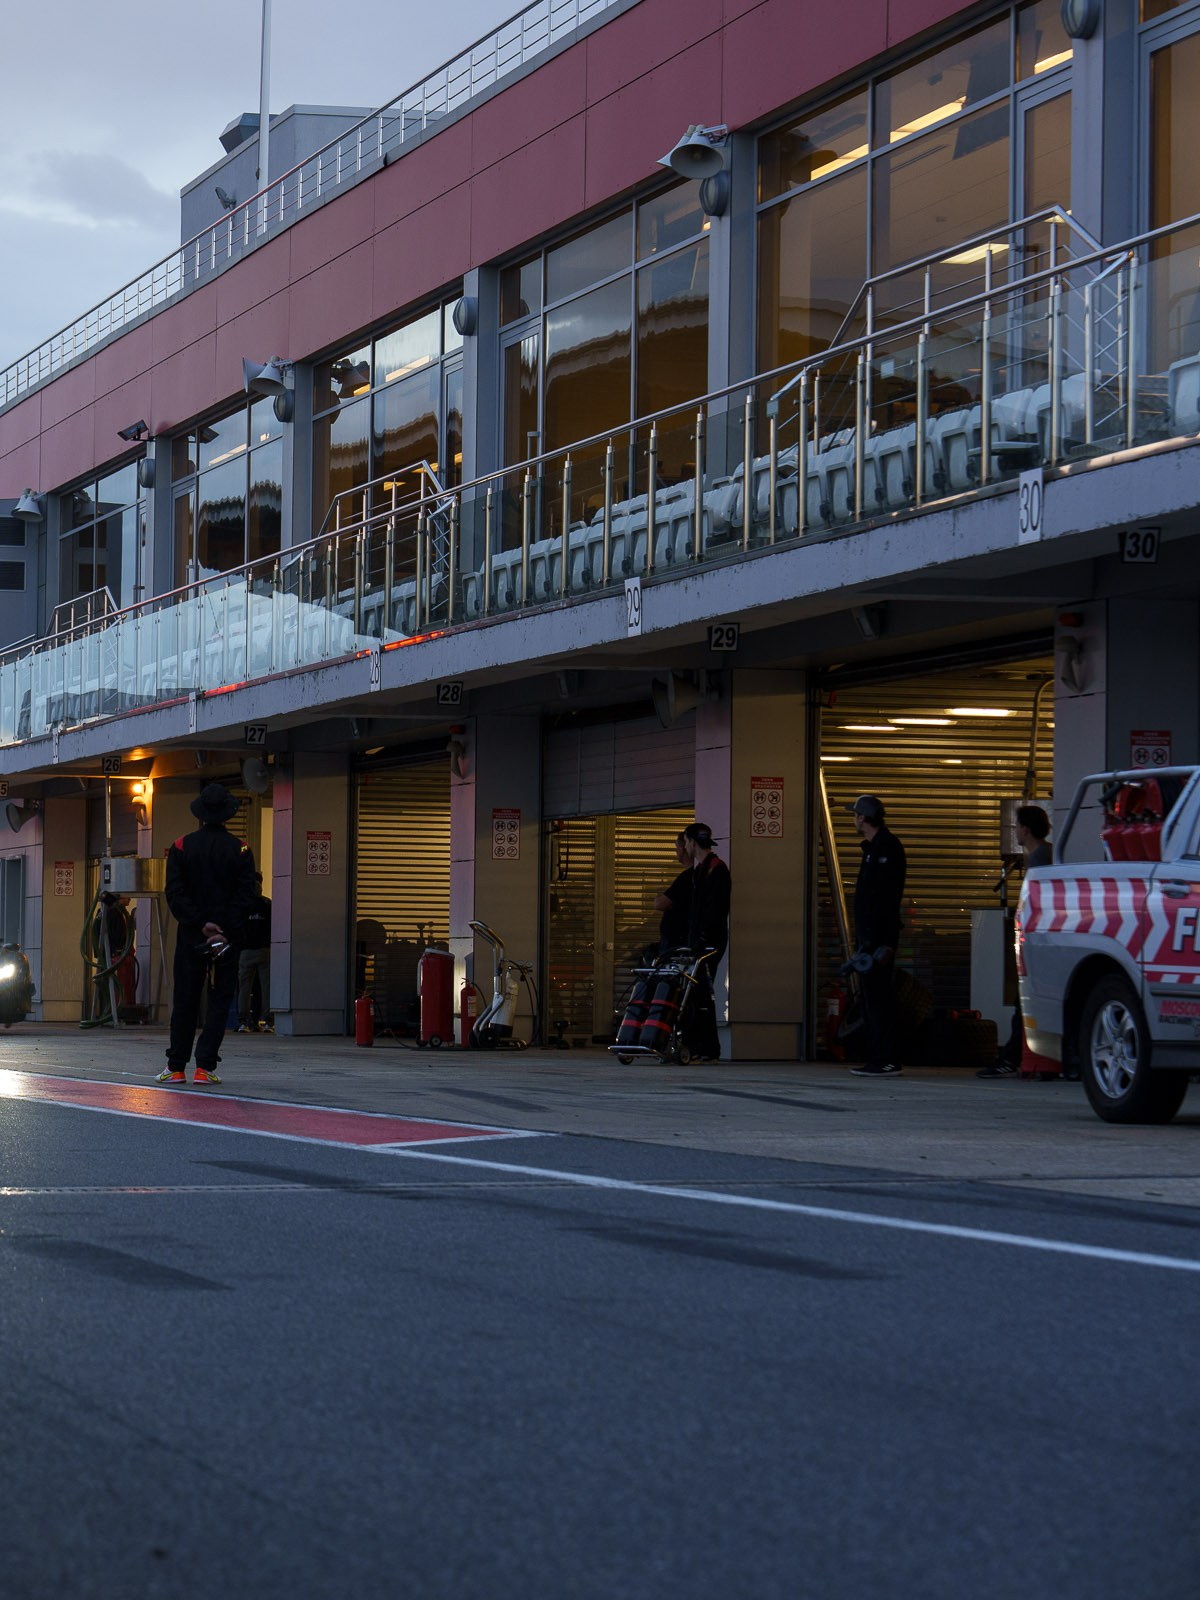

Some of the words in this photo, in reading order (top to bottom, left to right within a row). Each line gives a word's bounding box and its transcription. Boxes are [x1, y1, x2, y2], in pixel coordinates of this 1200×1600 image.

[1020, 480, 1041, 534] 30
[1127, 531, 1156, 559] 30
[626, 587, 640, 628] 29
[712, 627, 737, 648] 29
[370, 650, 380, 684] 28
[441, 684, 461, 702] 28
[248, 727, 265, 742] 27
[105, 759, 120, 772] 26
